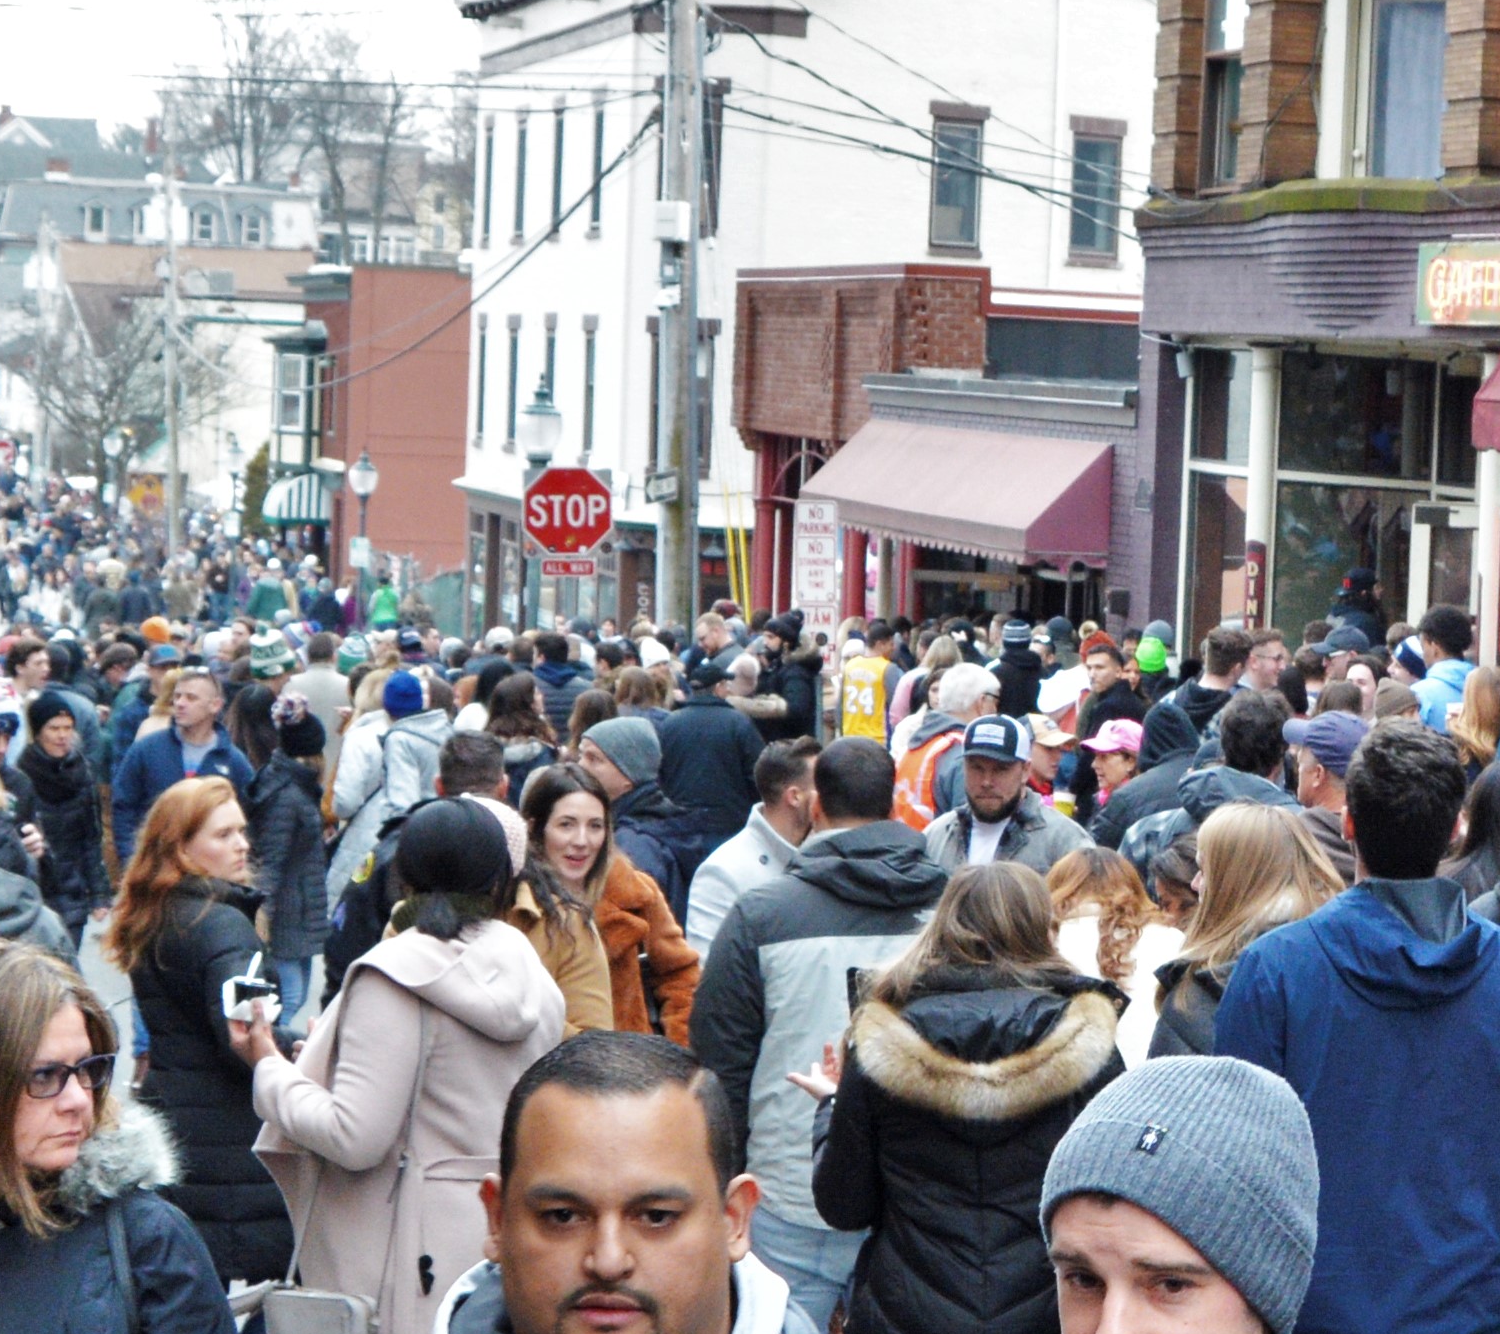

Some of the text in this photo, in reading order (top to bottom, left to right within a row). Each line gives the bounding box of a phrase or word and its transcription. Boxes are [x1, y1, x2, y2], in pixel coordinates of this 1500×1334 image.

[528, 494, 607, 528] STOP
[807, 508, 824, 520] NO
[799, 522, 835, 534] PARKING
[807, 541, 824, 554] NO
[544, 561, 592, 573] ALL WAY
[845, 686, 875, 716] 24
